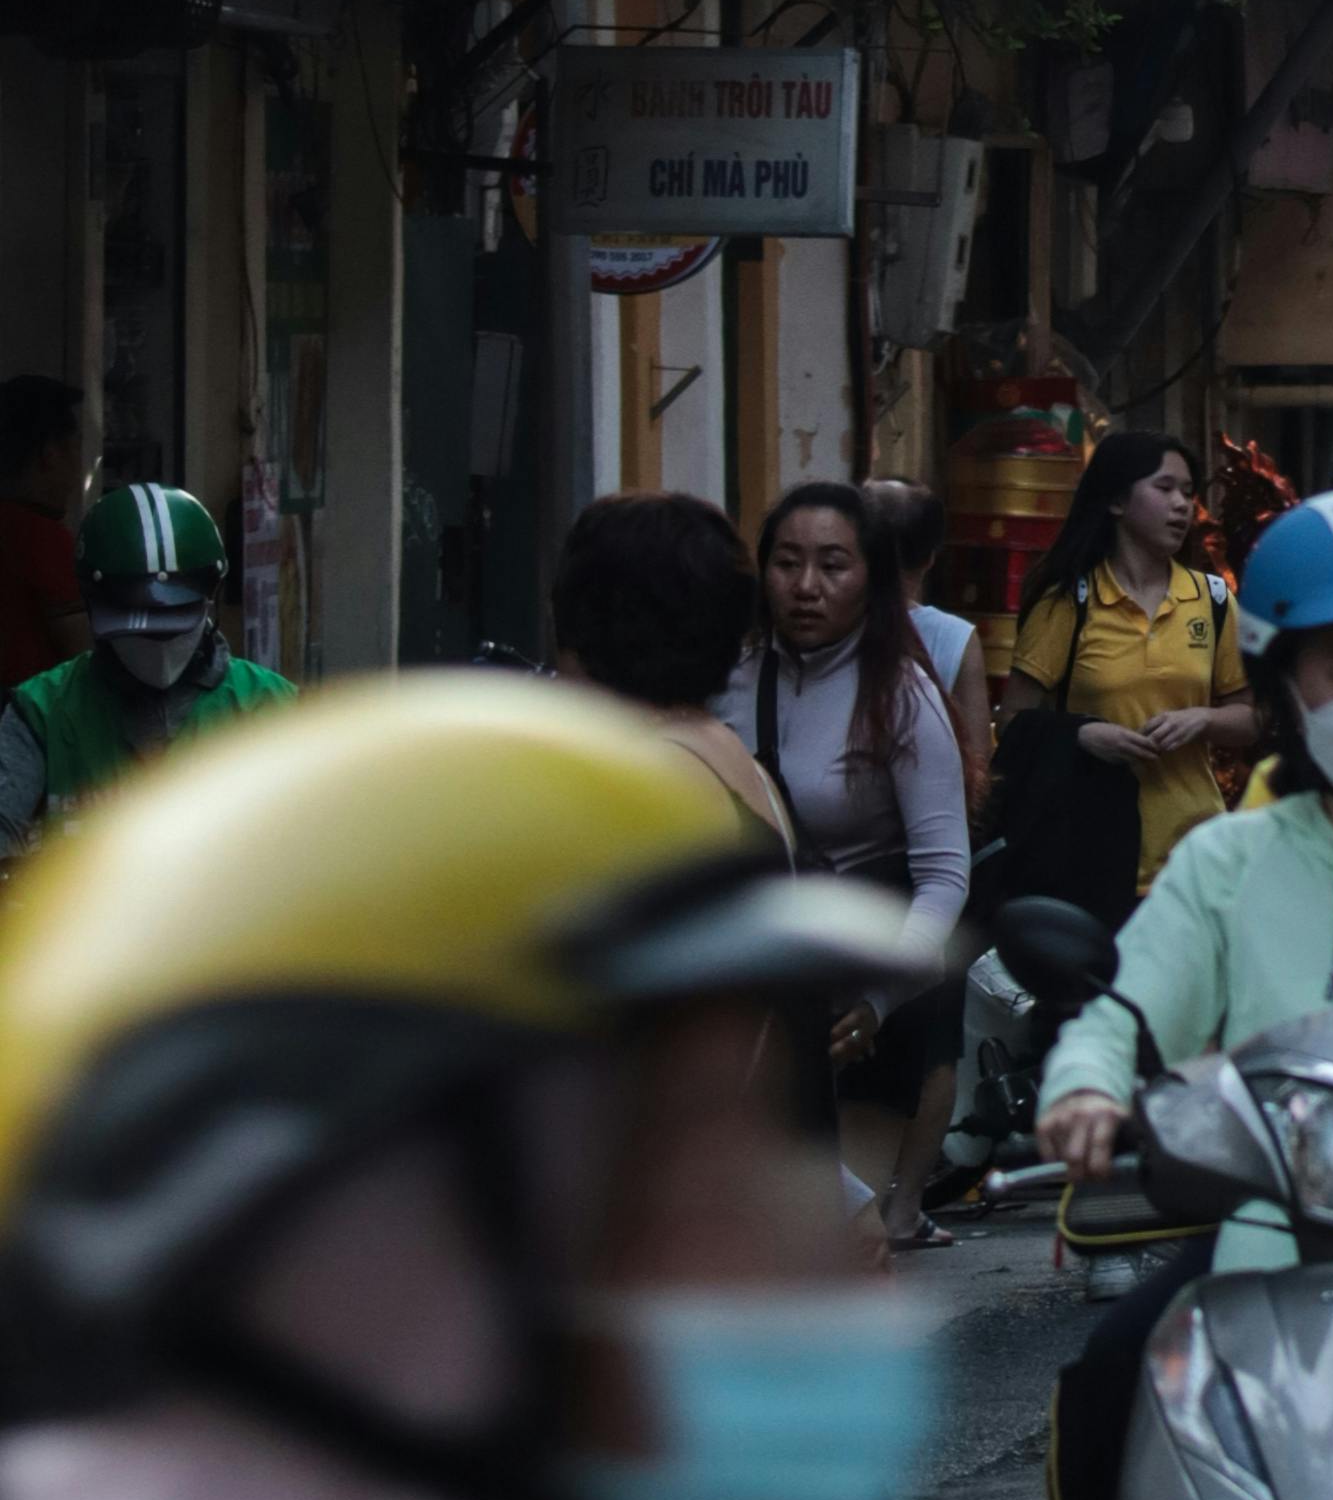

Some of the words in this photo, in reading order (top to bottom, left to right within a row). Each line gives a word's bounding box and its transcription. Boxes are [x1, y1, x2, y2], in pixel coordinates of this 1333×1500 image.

[782, 72, 833, 119] TÀU
[649, 151, 695, 198] CHÍ
[702, 151, 746, 198] MÀ
[755, 152, 809, 198] PHÙ
